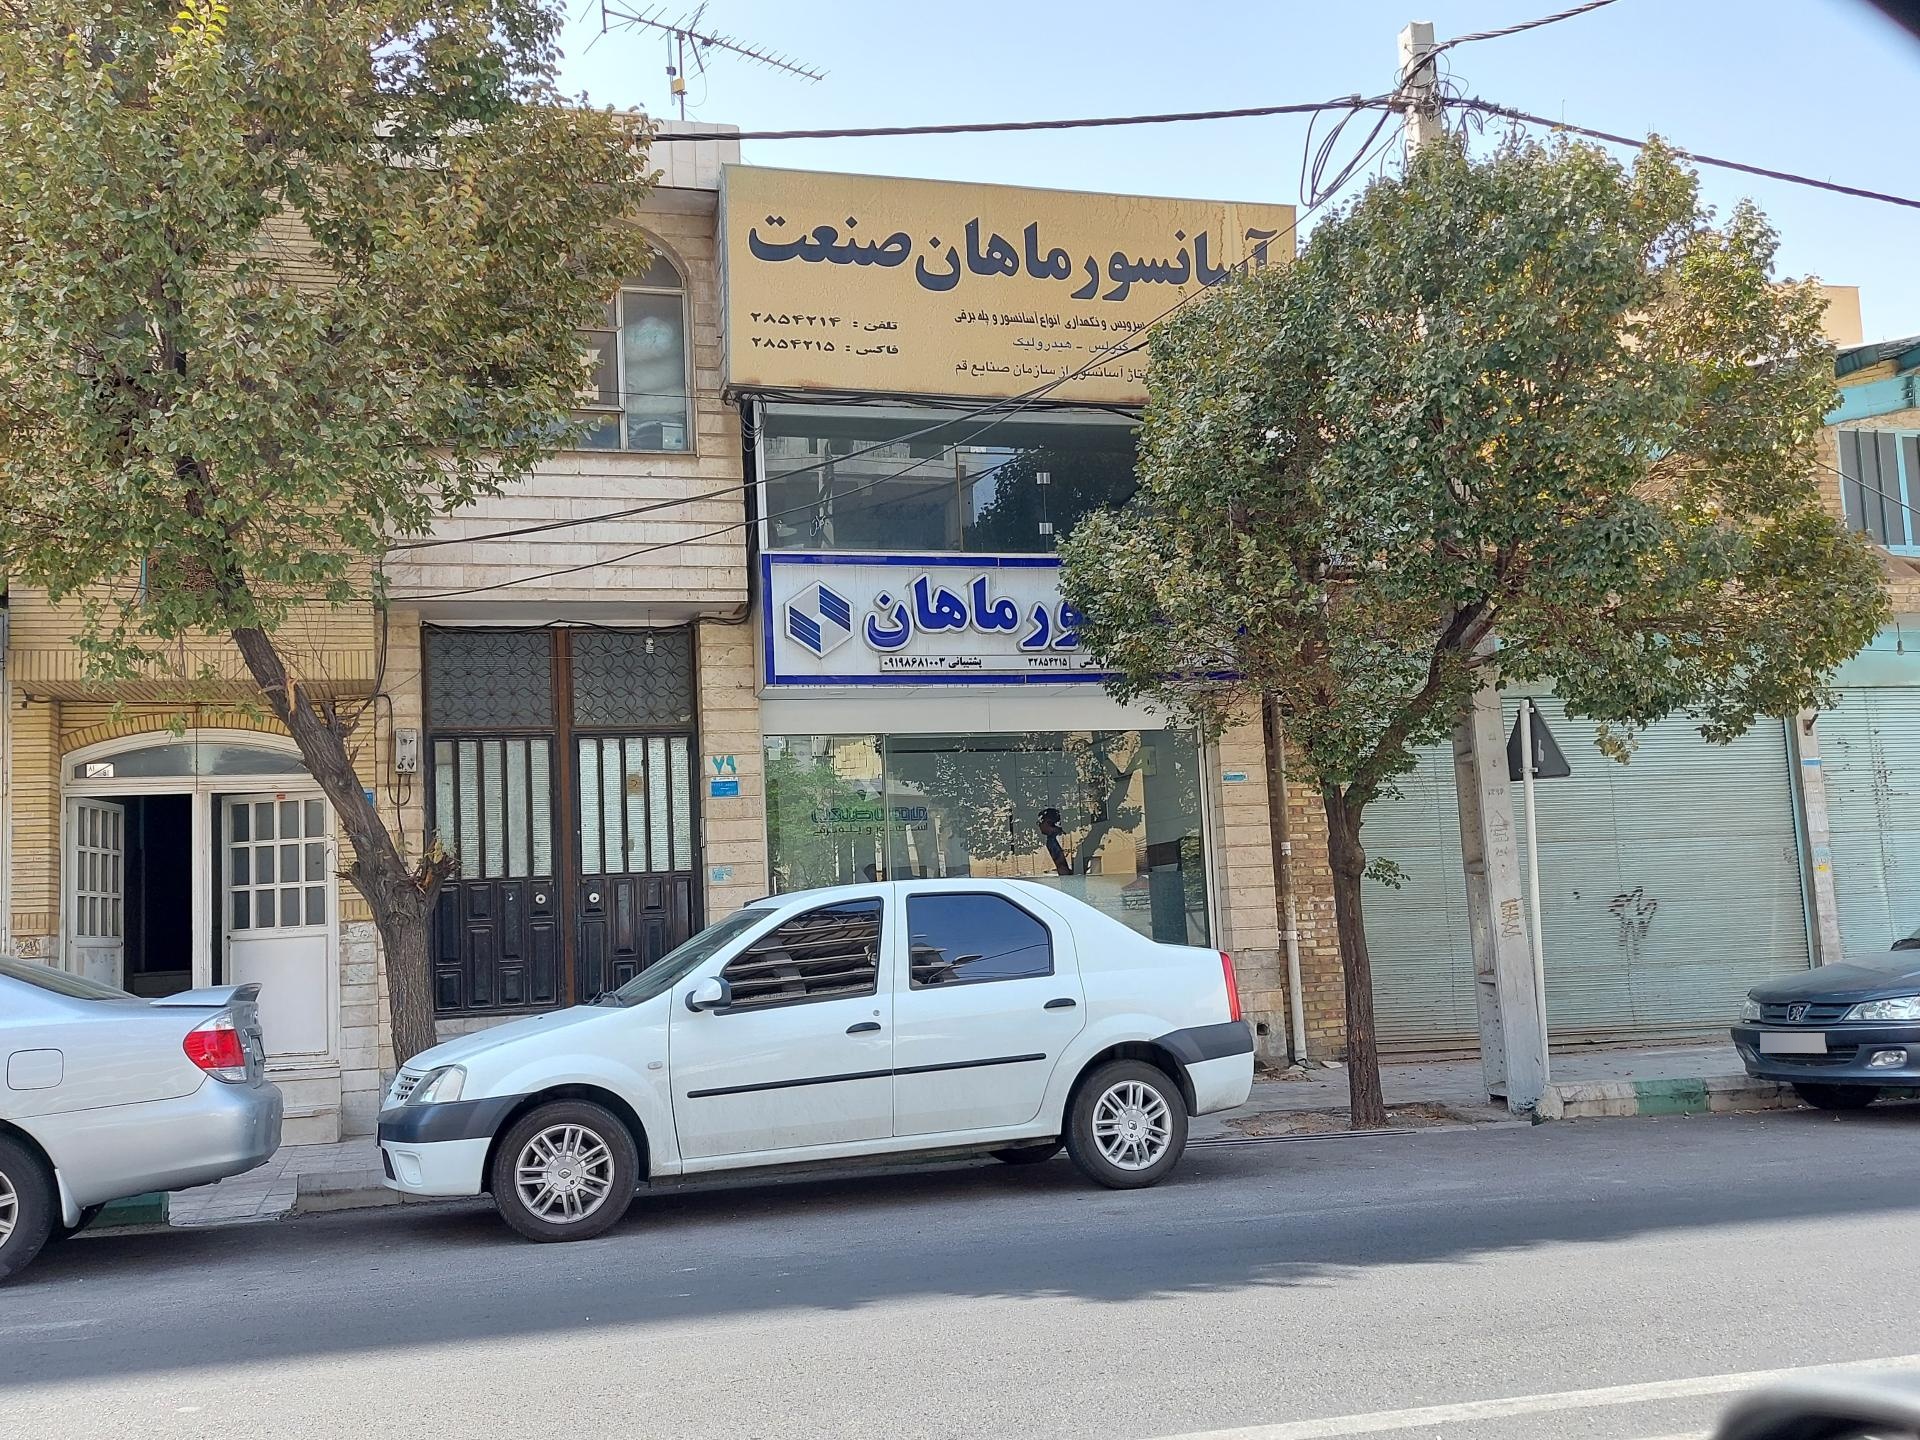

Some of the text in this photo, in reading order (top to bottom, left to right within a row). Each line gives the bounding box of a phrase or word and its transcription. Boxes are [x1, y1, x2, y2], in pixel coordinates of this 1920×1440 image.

[747, 215, 1278, 301] آسانسور ماهان صنعت
[750, 311, 841, 328] ۲۸۵۴۲۱۴
[954, 308, 976, 325] برقی
[992, 313, 998, 326] و
[1040, 313, 1061, 329] انواع
[863, 320, 899, 332] تلفن
[751, 337, 836, 352] ۲۸۵۴۲۱۵
[855, 344, 900, 356] فاکس
[1012, 337, 1072, 353] هیدرولیک
[955, 360, 968, 375] قم
[971, 361, 1010, 377] صنایع
[1013, 363, 1056, 380] سازمان
[863, 572, 1020, 652] ماهان
[883, 657, 946, 668] ۰۹۱۹۸۶۸۱۰۰۳
[948, 656, 983, 668] پشتیبانی
[712, 755, 737, 775] ۷۹
